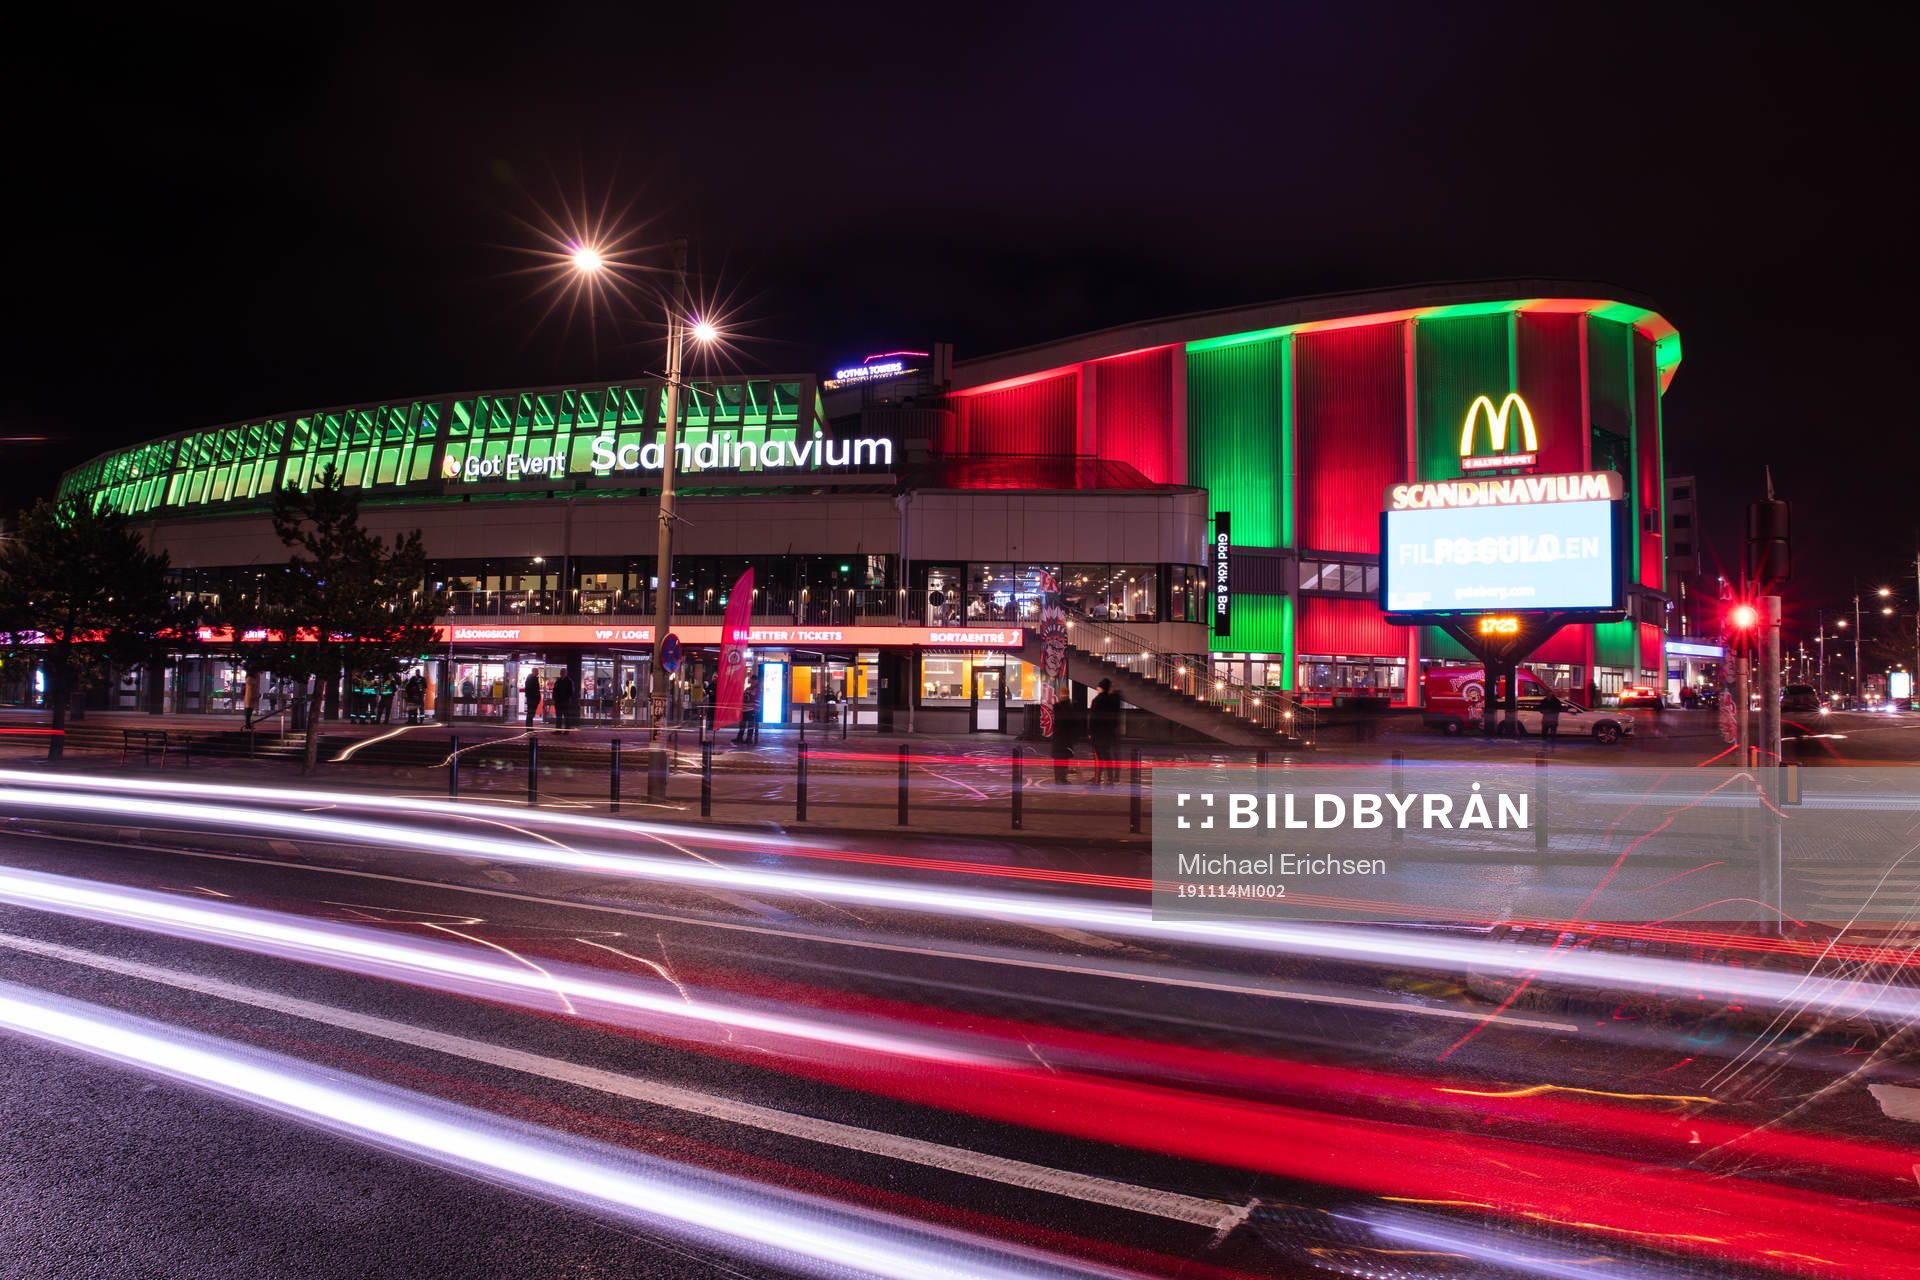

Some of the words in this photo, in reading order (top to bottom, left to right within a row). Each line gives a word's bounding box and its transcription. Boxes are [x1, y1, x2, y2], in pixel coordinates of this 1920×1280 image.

[837, 367, 869, 379] GOTHIA
[869, 362, 902, 375] TOWERS
[590, 431, 893, 471] Scandinavium
[465, 455, 501, 477] Got
[506, 451, 566, 475] Event
[1392, 474, 1611, 509] SCANDINAVIUM
[1218, 533, 1228, 559] Glöd
[1218, 562, 1228, 583] Kök
[1218, 596, 1228, 615] Bar
[455, 629, 521, 639] SÄSONGSKORT
[596, 630, 613, 639] VIP
[622, 630, 649, 639] LOGE
[733, 630, 788, 641] BILJETTER
[798, 631, 842, 641] TICKETS
[930, 632, 1005, 643] BORTAENTRÉ
